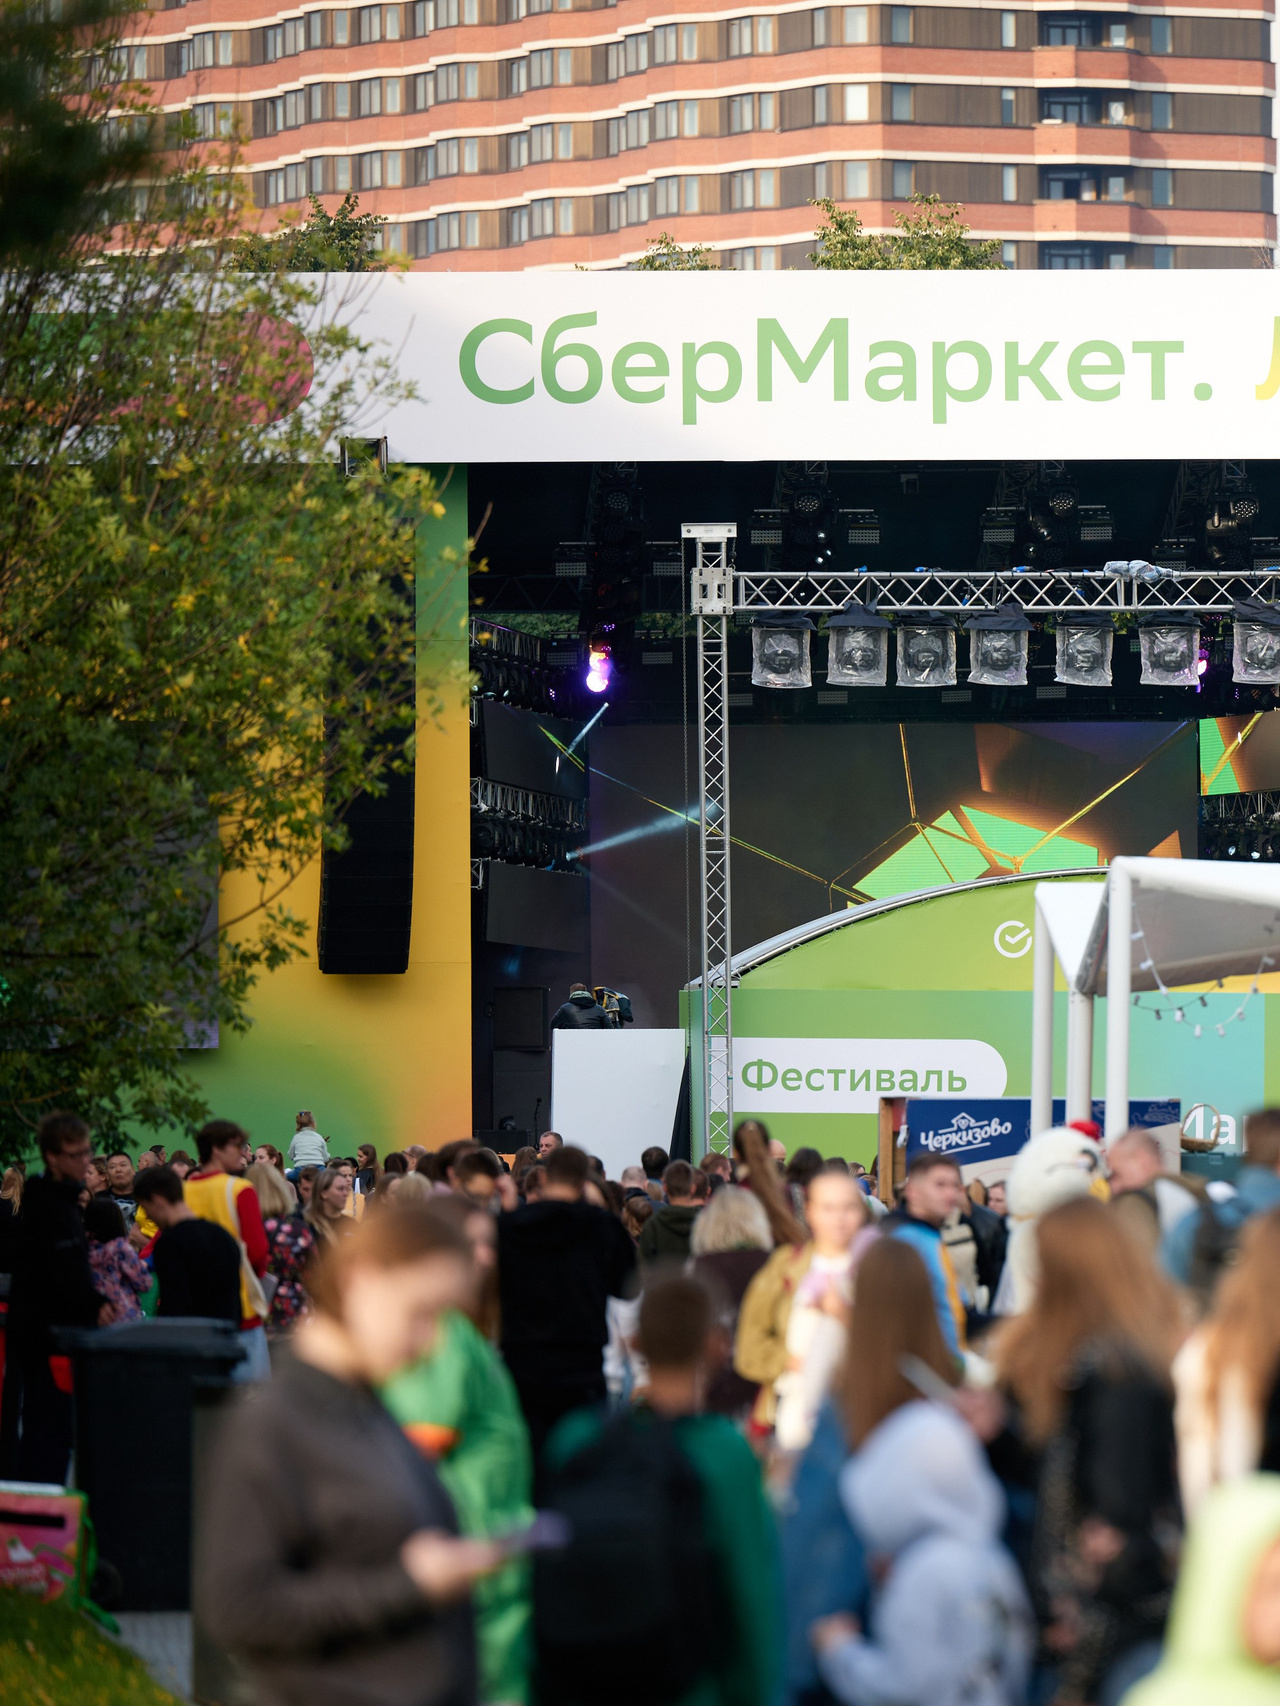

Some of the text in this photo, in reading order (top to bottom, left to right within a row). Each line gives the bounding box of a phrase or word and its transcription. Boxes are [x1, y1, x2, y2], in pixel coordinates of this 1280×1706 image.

[458, 310, 1213, 425] СберМаркет.
[741, 1058, 968, 1093] Фестиваль
[920, 1117, 1012, 1152] Черкизово
